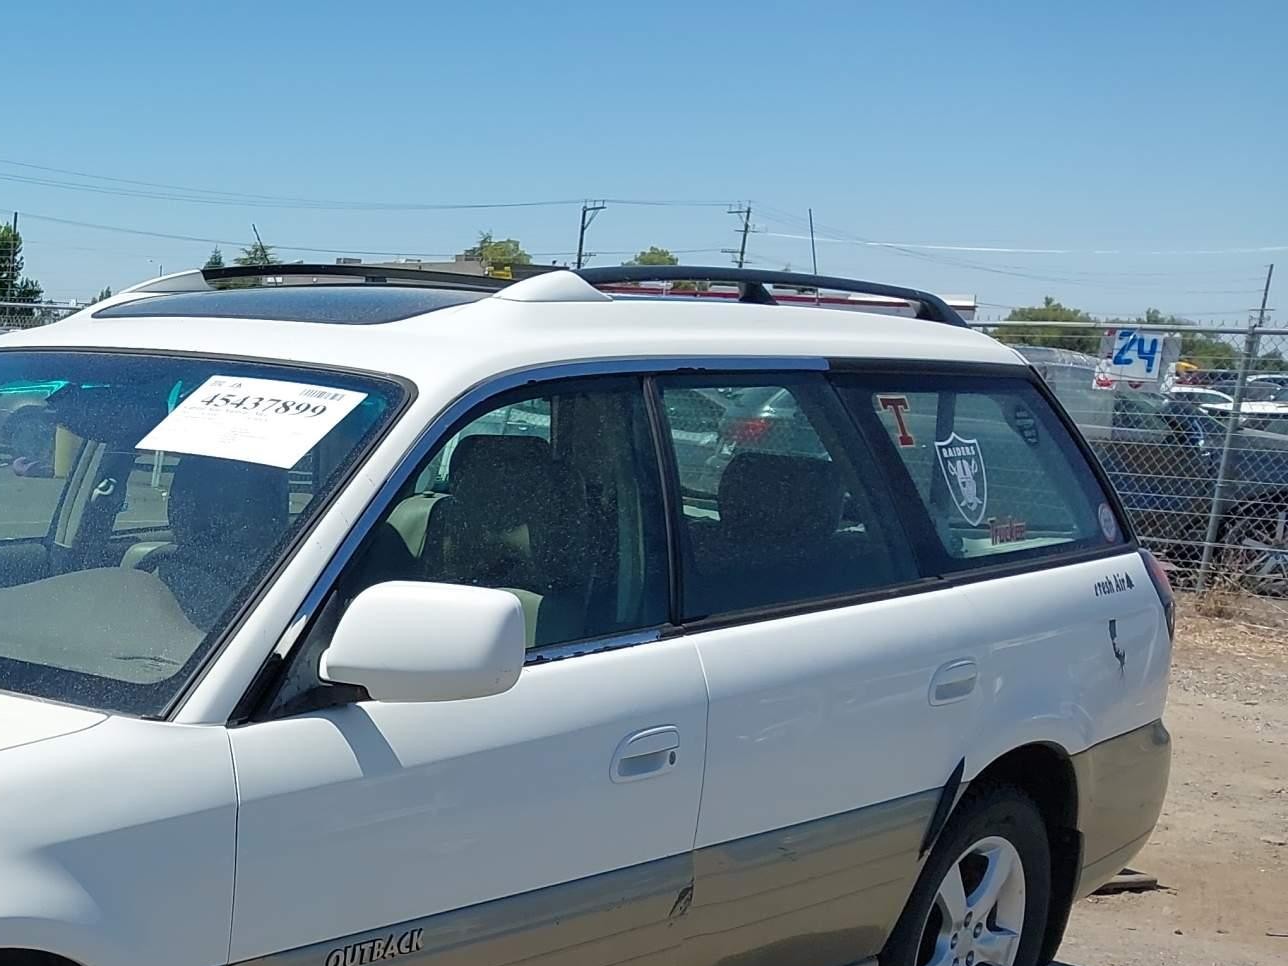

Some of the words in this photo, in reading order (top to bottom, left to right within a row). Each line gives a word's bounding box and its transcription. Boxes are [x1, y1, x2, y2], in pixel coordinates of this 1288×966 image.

[1113, 330, 1158, 373] 24
[200, 392, 328, 418] 45437899
[876, 394, 916, 448] T
[941, 445, 976, 458] RAIDERS
[1112, 573, 1127, 592] Air
